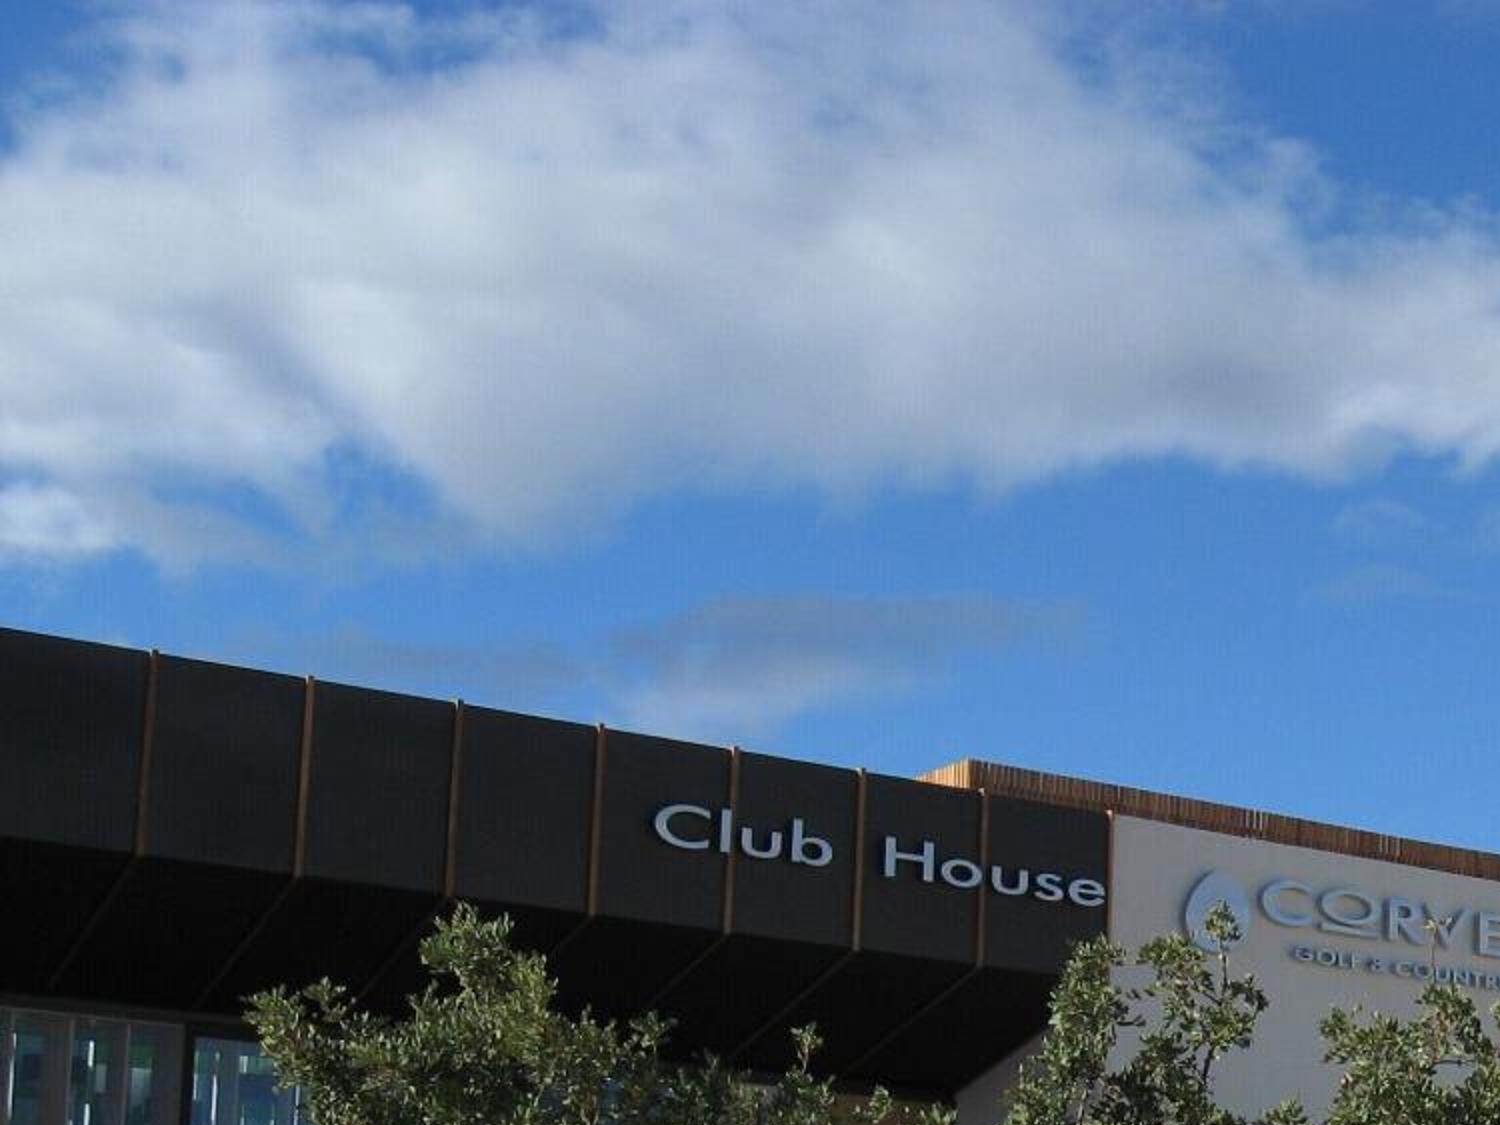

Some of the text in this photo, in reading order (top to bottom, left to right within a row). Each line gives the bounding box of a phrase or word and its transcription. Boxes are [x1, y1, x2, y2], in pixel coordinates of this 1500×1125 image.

[653, 803, 1106, 908] Club House
[1294, 945, 1361, 970] GOLF
